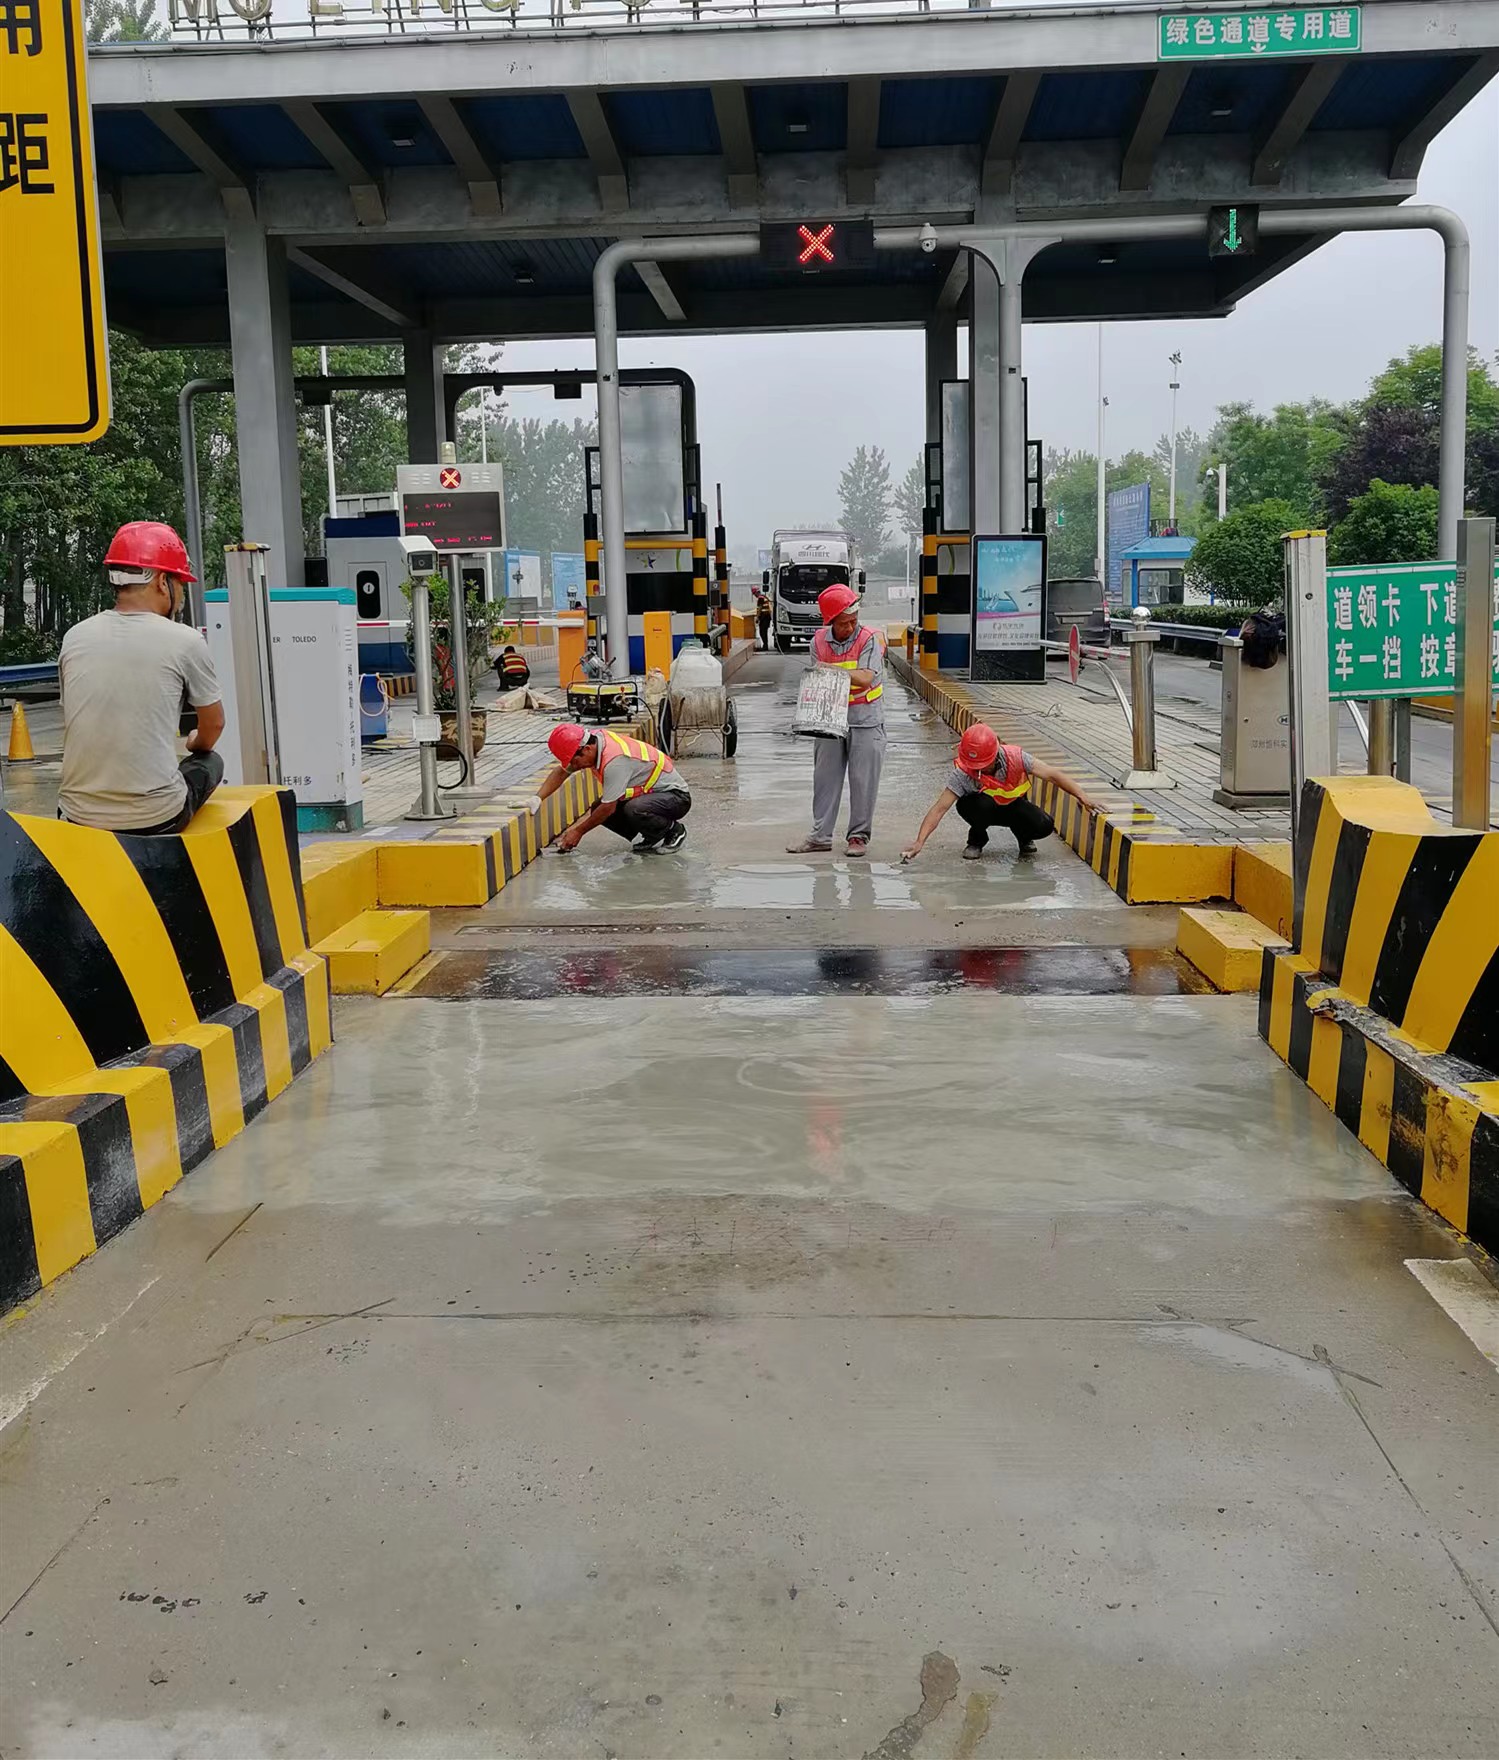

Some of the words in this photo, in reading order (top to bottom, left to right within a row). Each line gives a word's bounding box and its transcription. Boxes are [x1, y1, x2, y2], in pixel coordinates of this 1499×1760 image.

[1166, 11, 1352, 45] 绿色通道专用道
[1334, 584, 1401, 631] 道领卡
[292, 635, 317, 643] TOLEDO
[1335, 635, 1402, 681] 车一挡
